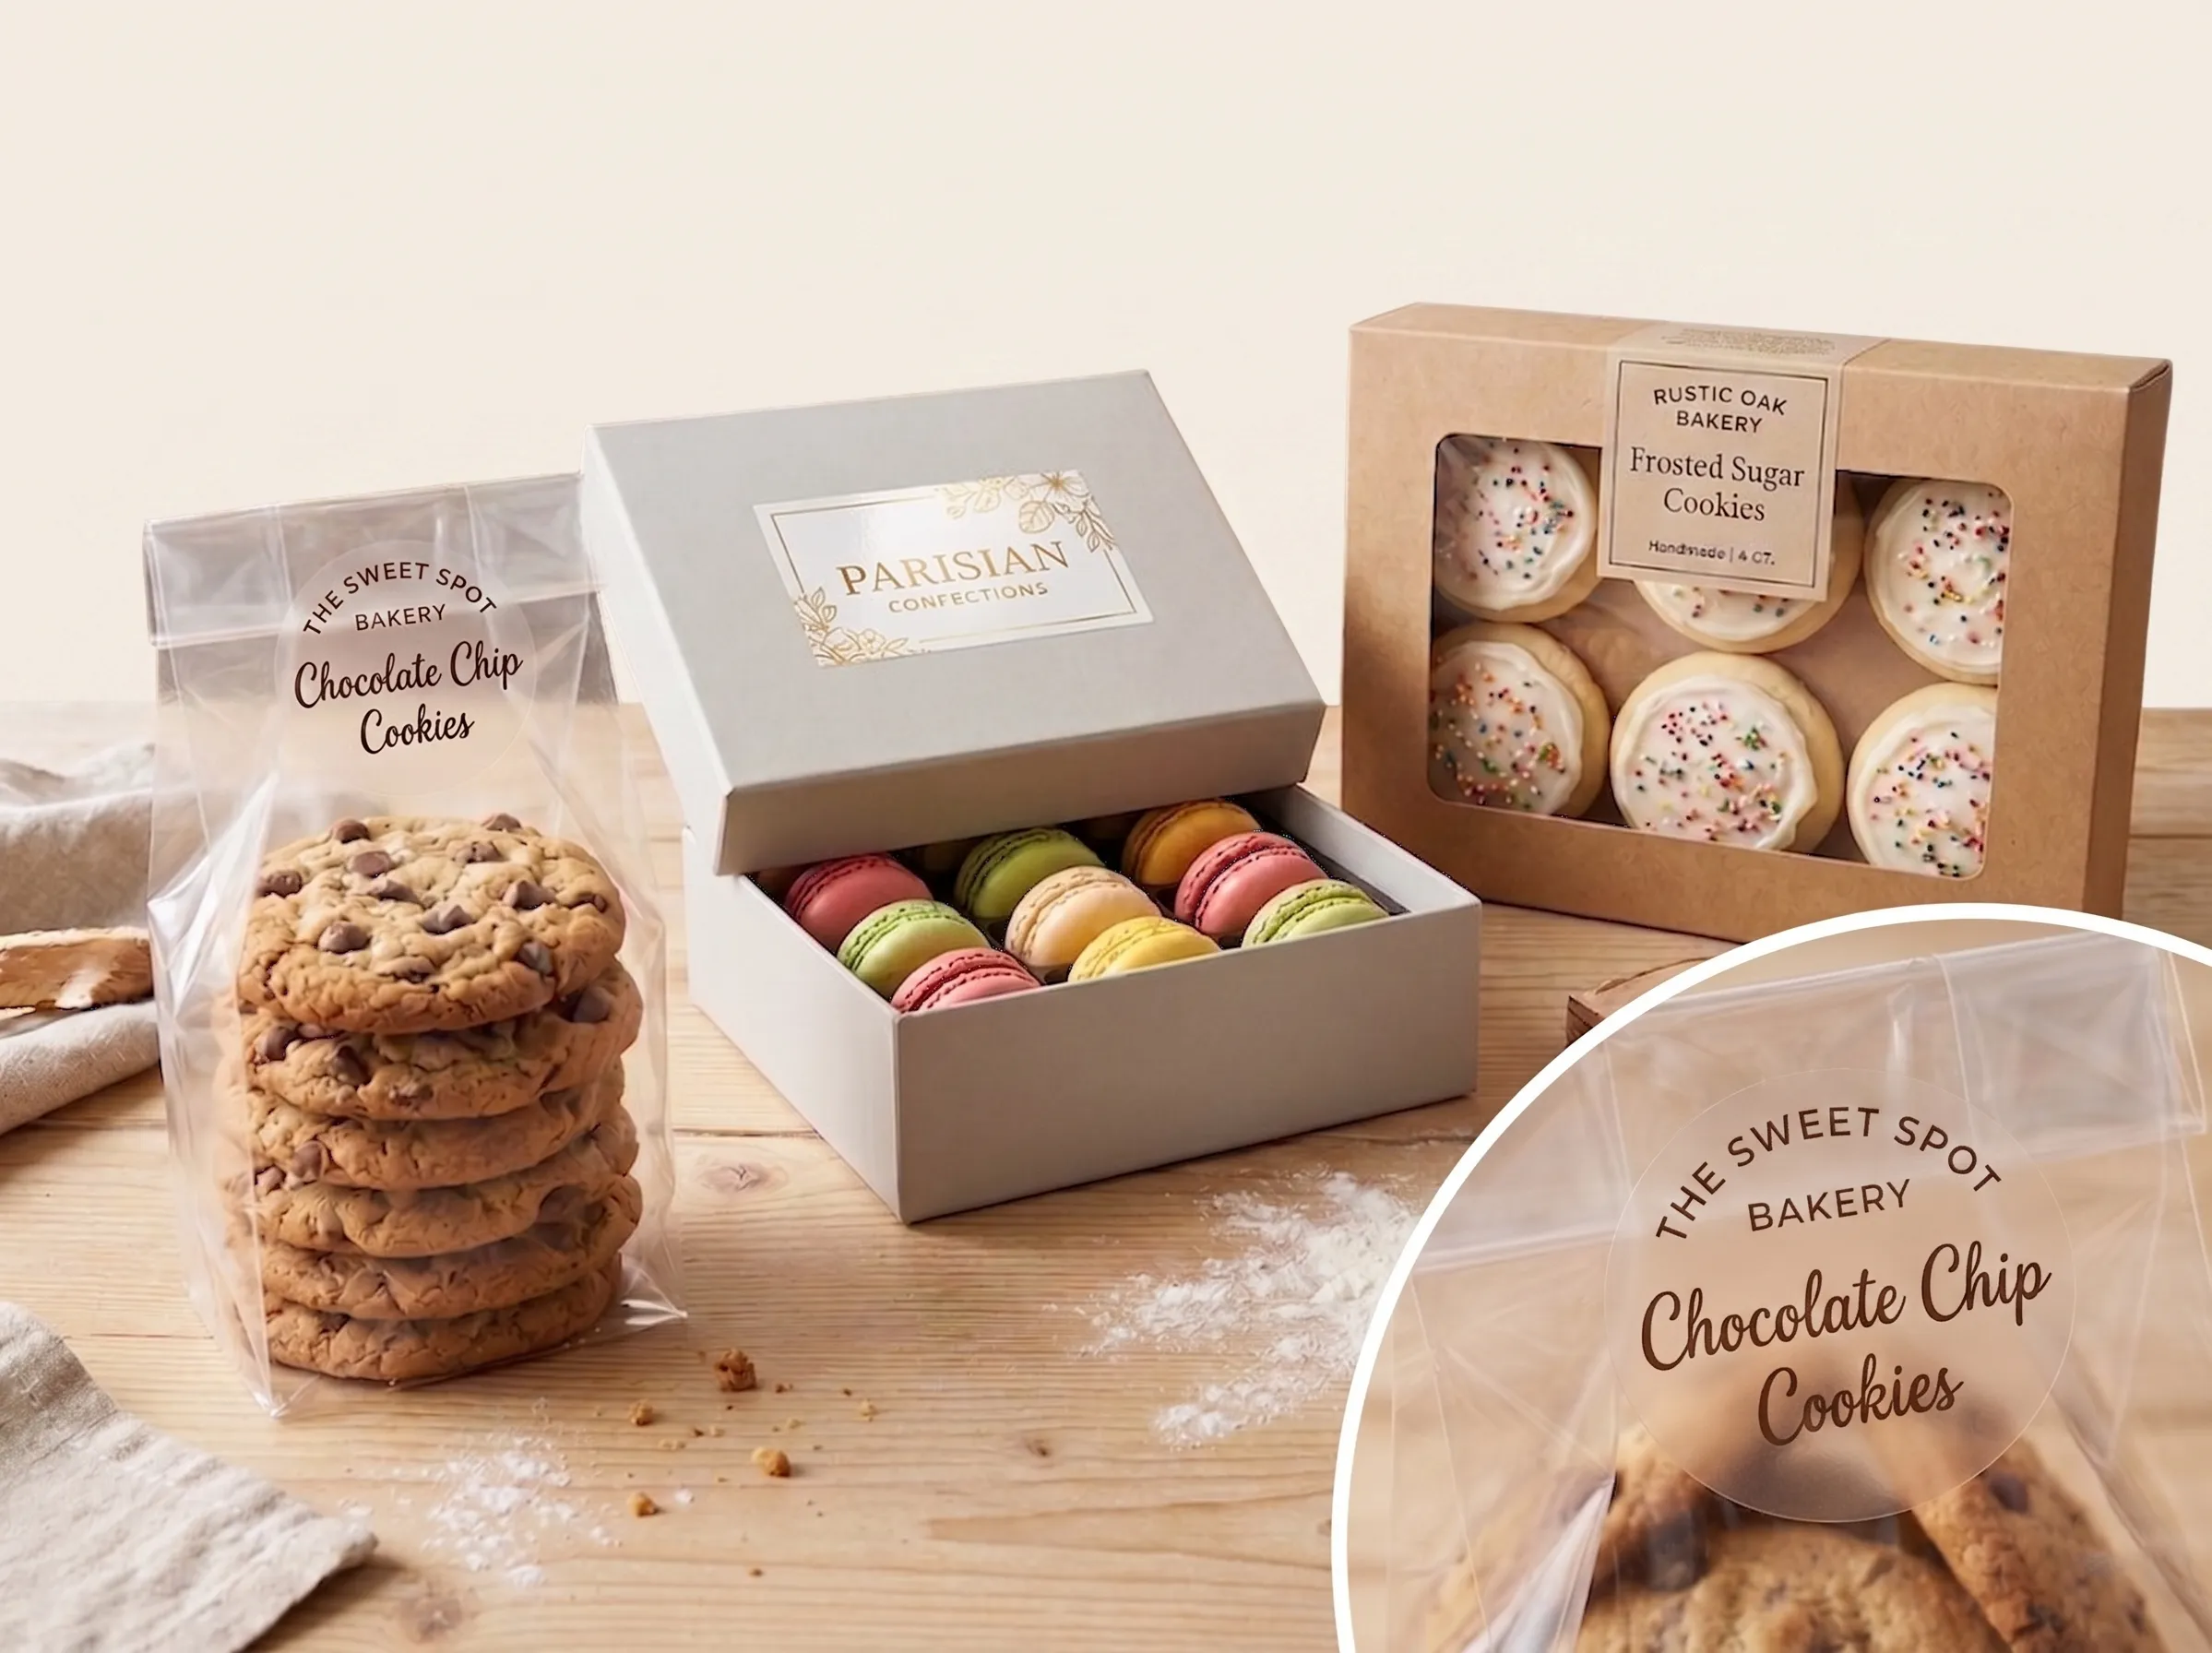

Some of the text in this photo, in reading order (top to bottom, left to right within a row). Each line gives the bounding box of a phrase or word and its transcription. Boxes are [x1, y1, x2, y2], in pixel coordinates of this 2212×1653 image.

[1653, 386, 1788, 415] RUSTIC OAK
[1676, 410, 1763, 434] BAKERY
[1630, 446, 1805, 492] Frosted Sugar
[1663, 488, 1766, 521] Cookies
[836, 541, 1069, 596] PARISIAN
[303, 562, 497, 635] THE SWEET SPOT
[355, 604, 446, 631] BAKERY
[888, 581, 1048, 612] CONFECTIONS
[294, 640, 524, 708] Chocolate Chip
[361, 703, 475, 754] Cookies
[1656, 1107, 2002, 1240] THE SWEET SPOT
[1748, 1179, 1910, 1231] BAKERY
[1641, 1241, 2052, 1372] Chocolate Chip
[1758, 1353, 1965, 1446] Cookies
